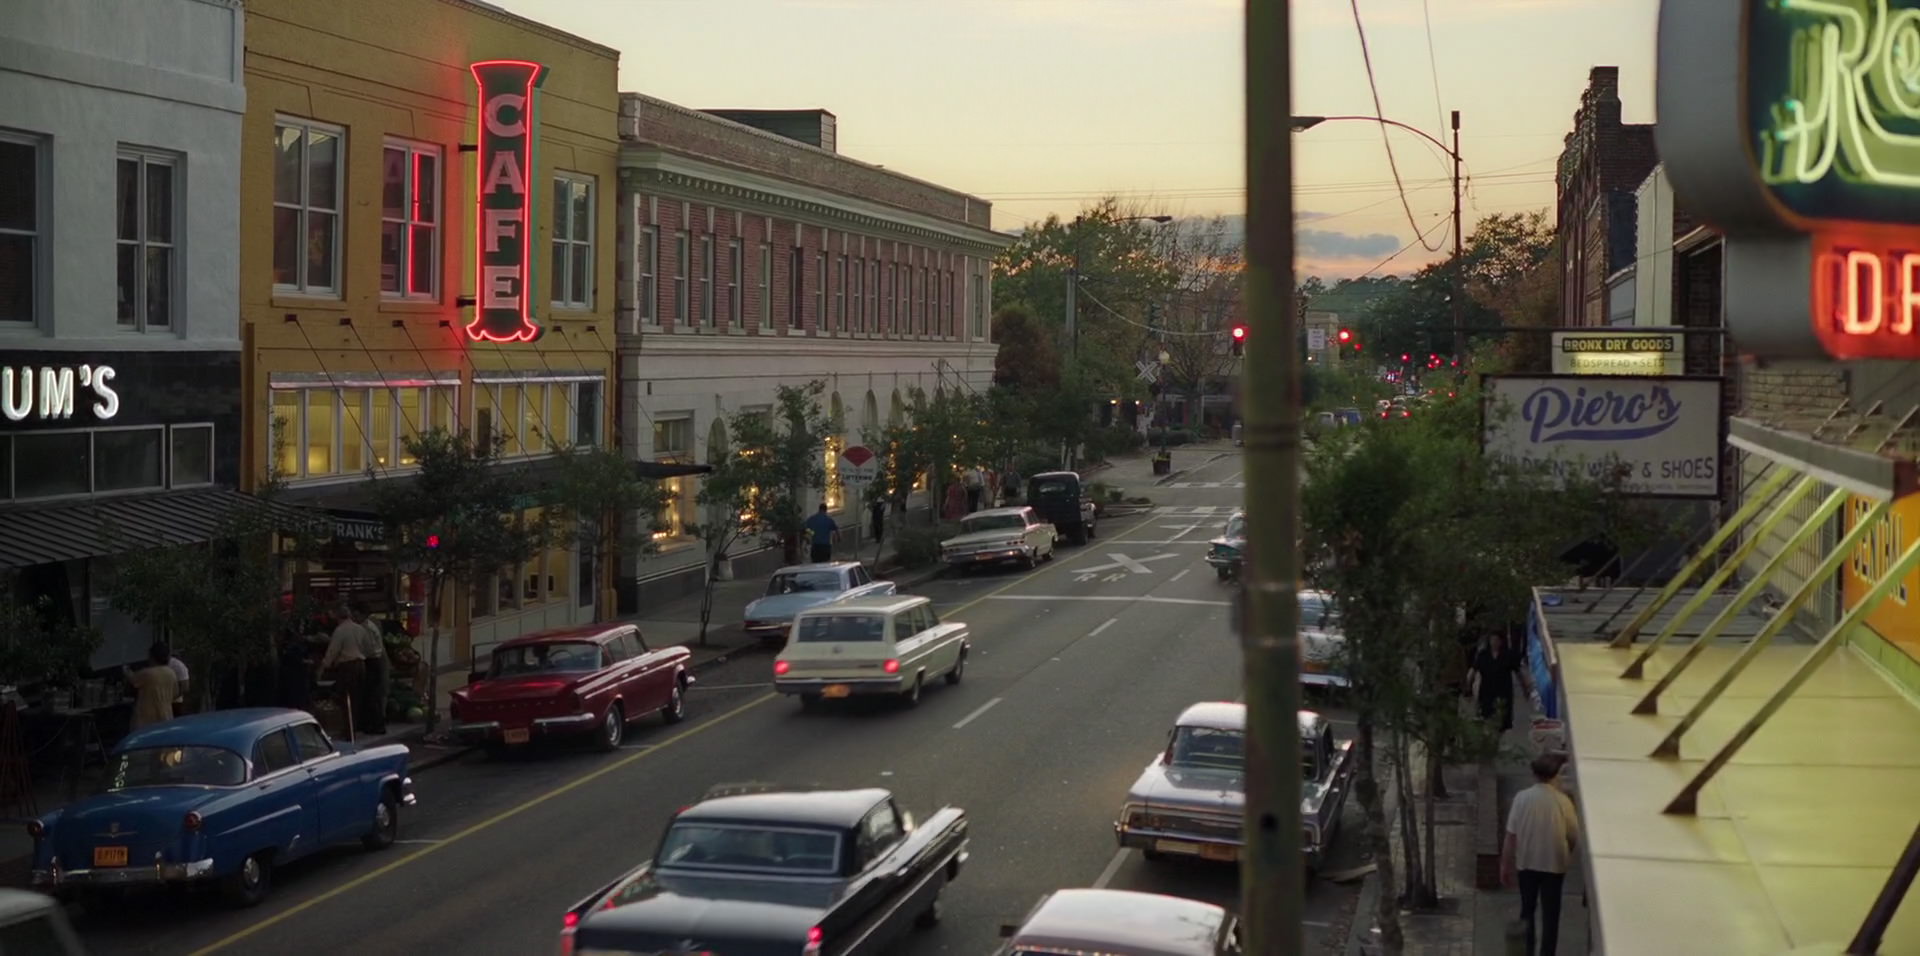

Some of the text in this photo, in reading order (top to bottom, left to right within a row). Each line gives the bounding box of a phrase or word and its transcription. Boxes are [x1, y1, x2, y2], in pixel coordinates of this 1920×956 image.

[484, 93, 527, 311] CAFE
[1564, 339, 1672, 351] BRONX DRY GOODS
[2, 364, 119, 420] UM'S
[1522, 386, 1682, 443] Piero's
[1641, 461, 1652, 478] &
[1661, 457, 1714, 479] SHOES
[330, 522, 384, 540] RANK'S
